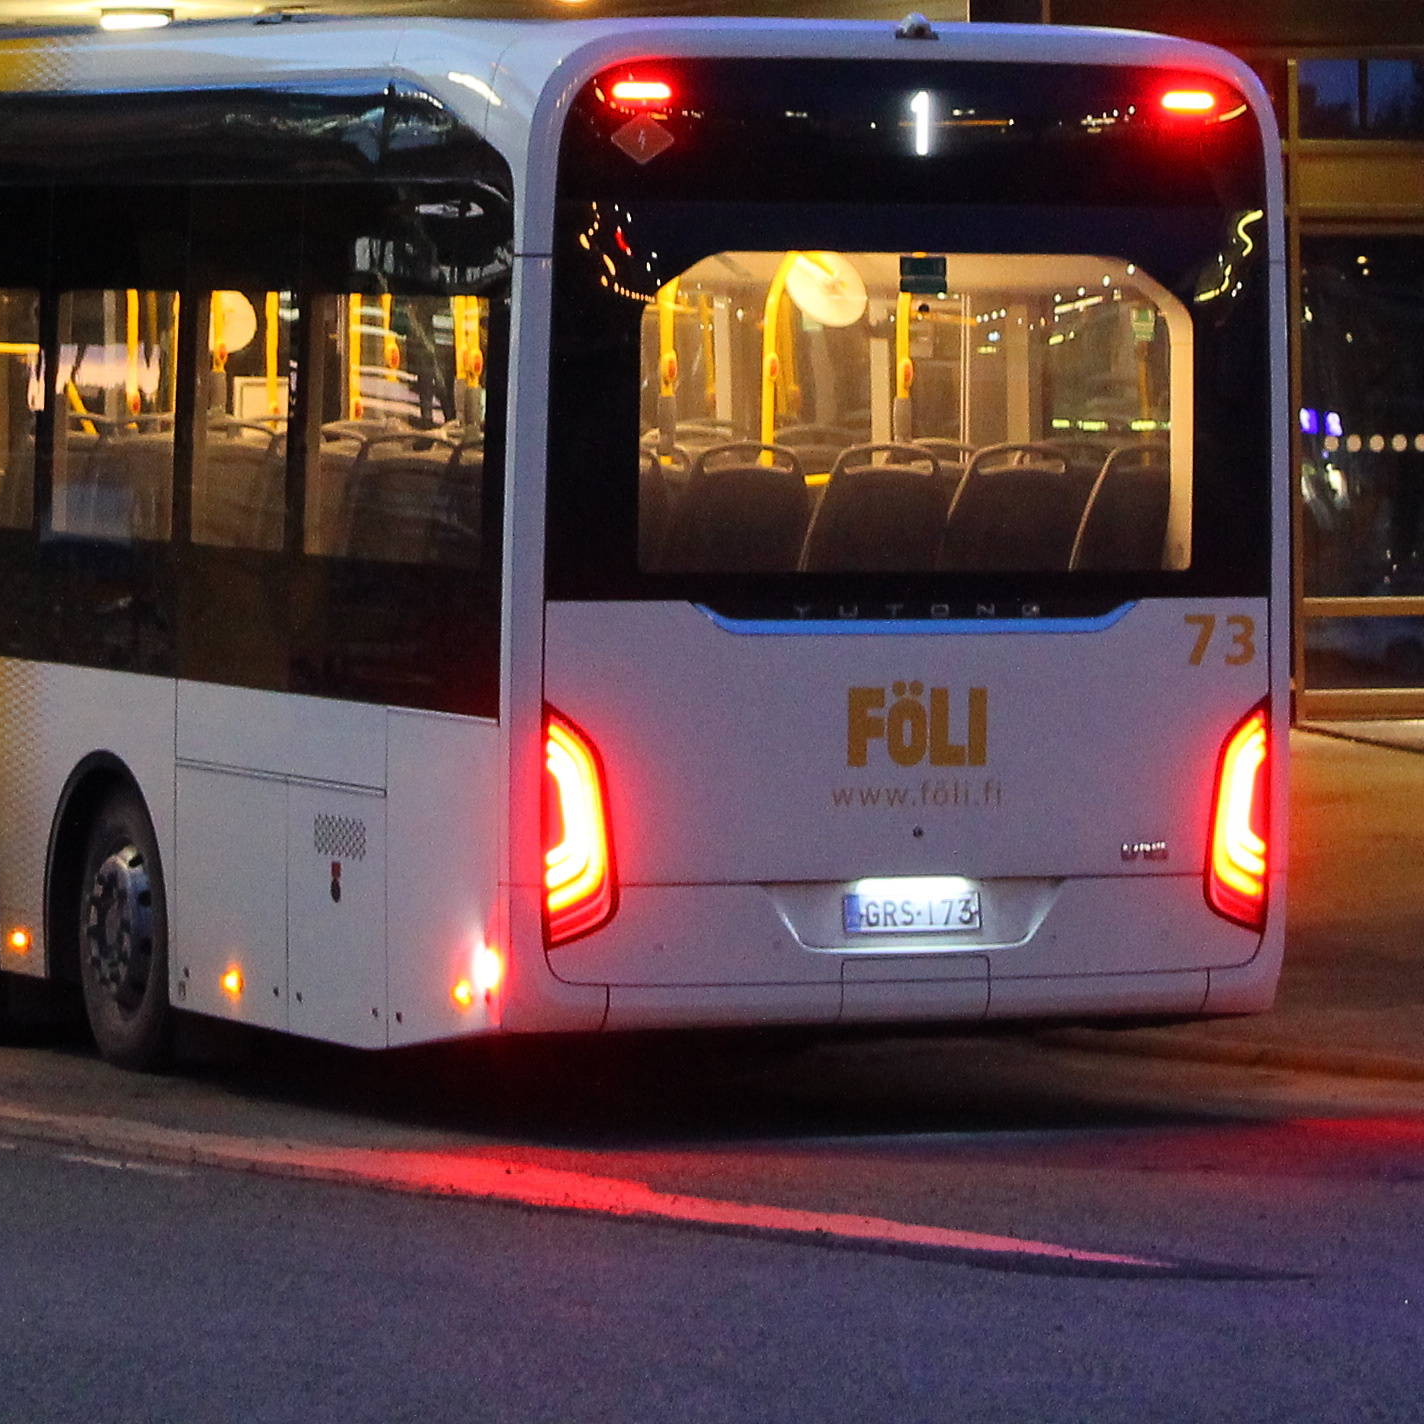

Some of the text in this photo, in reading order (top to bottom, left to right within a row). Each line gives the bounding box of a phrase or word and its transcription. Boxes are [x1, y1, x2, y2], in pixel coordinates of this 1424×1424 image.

[909, 89, 930, 156] 1
[793, 602, 1041, 618] YUTONG
[1183, 614, 1256, 666] 73
[831, 778, 1003, 808] www.föli.fi
[864, 898, 976, 927] GRS-173
